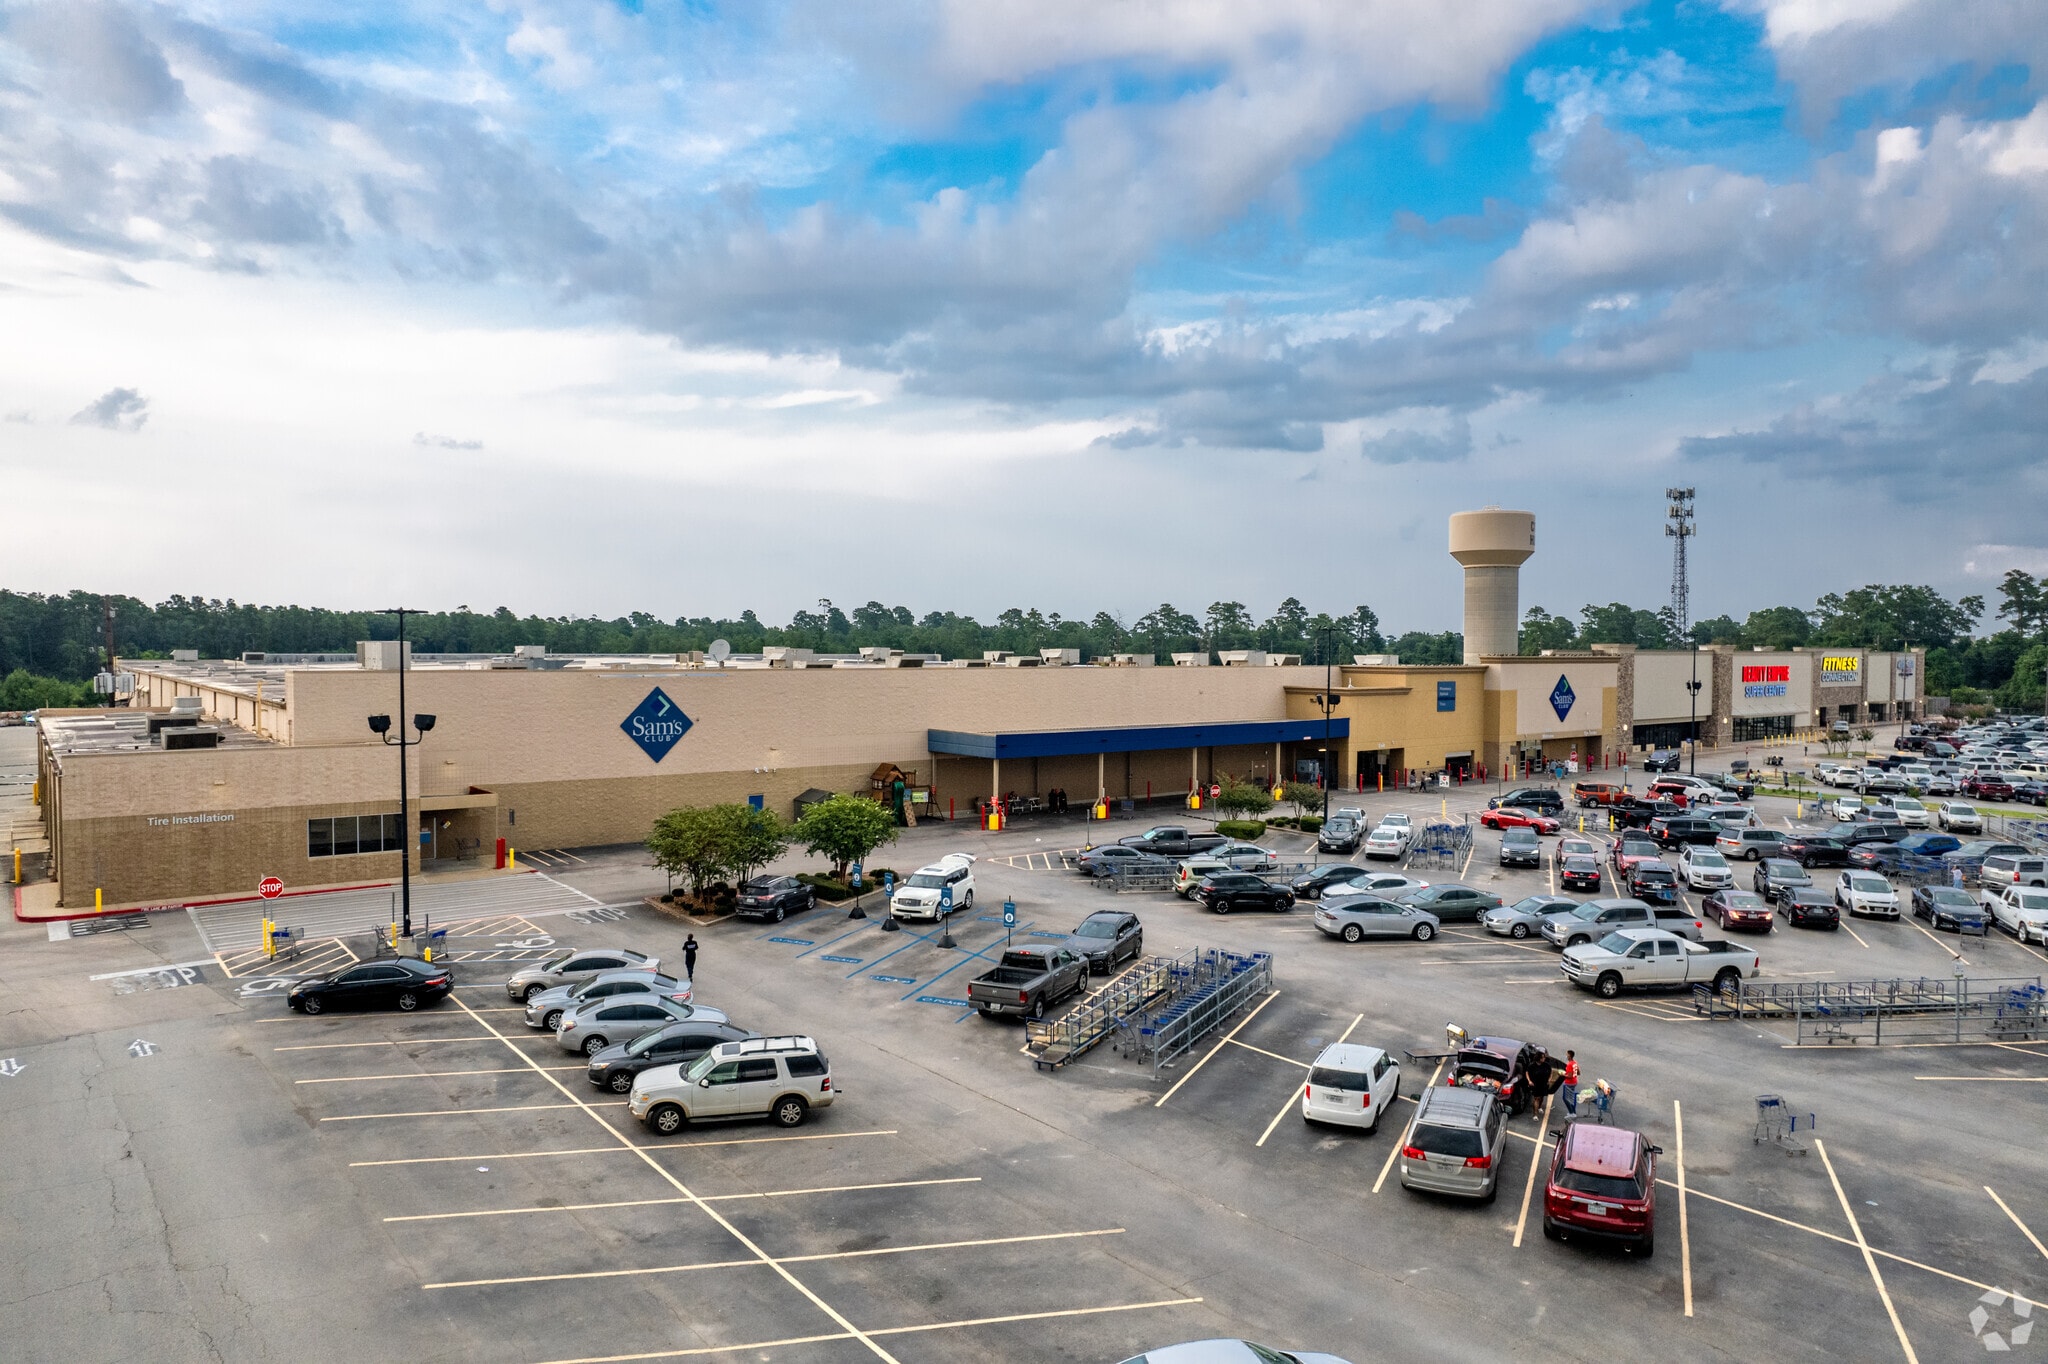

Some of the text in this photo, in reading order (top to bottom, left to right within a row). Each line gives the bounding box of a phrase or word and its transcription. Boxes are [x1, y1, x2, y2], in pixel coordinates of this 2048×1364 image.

[1822, 656, 1858, 671] FITNESS
[1821, 672, 1858, 683] CONNECTION
[1554, 691, 1573, 704] Sam's
[632, 715, 682, 736] Sam's
[147, 813, 235, 826] Tire Installation
[260, 883, 282, 893] STOP
[564, 906, 631, 925] STOP
[112, 967, 197, 995] STOP
